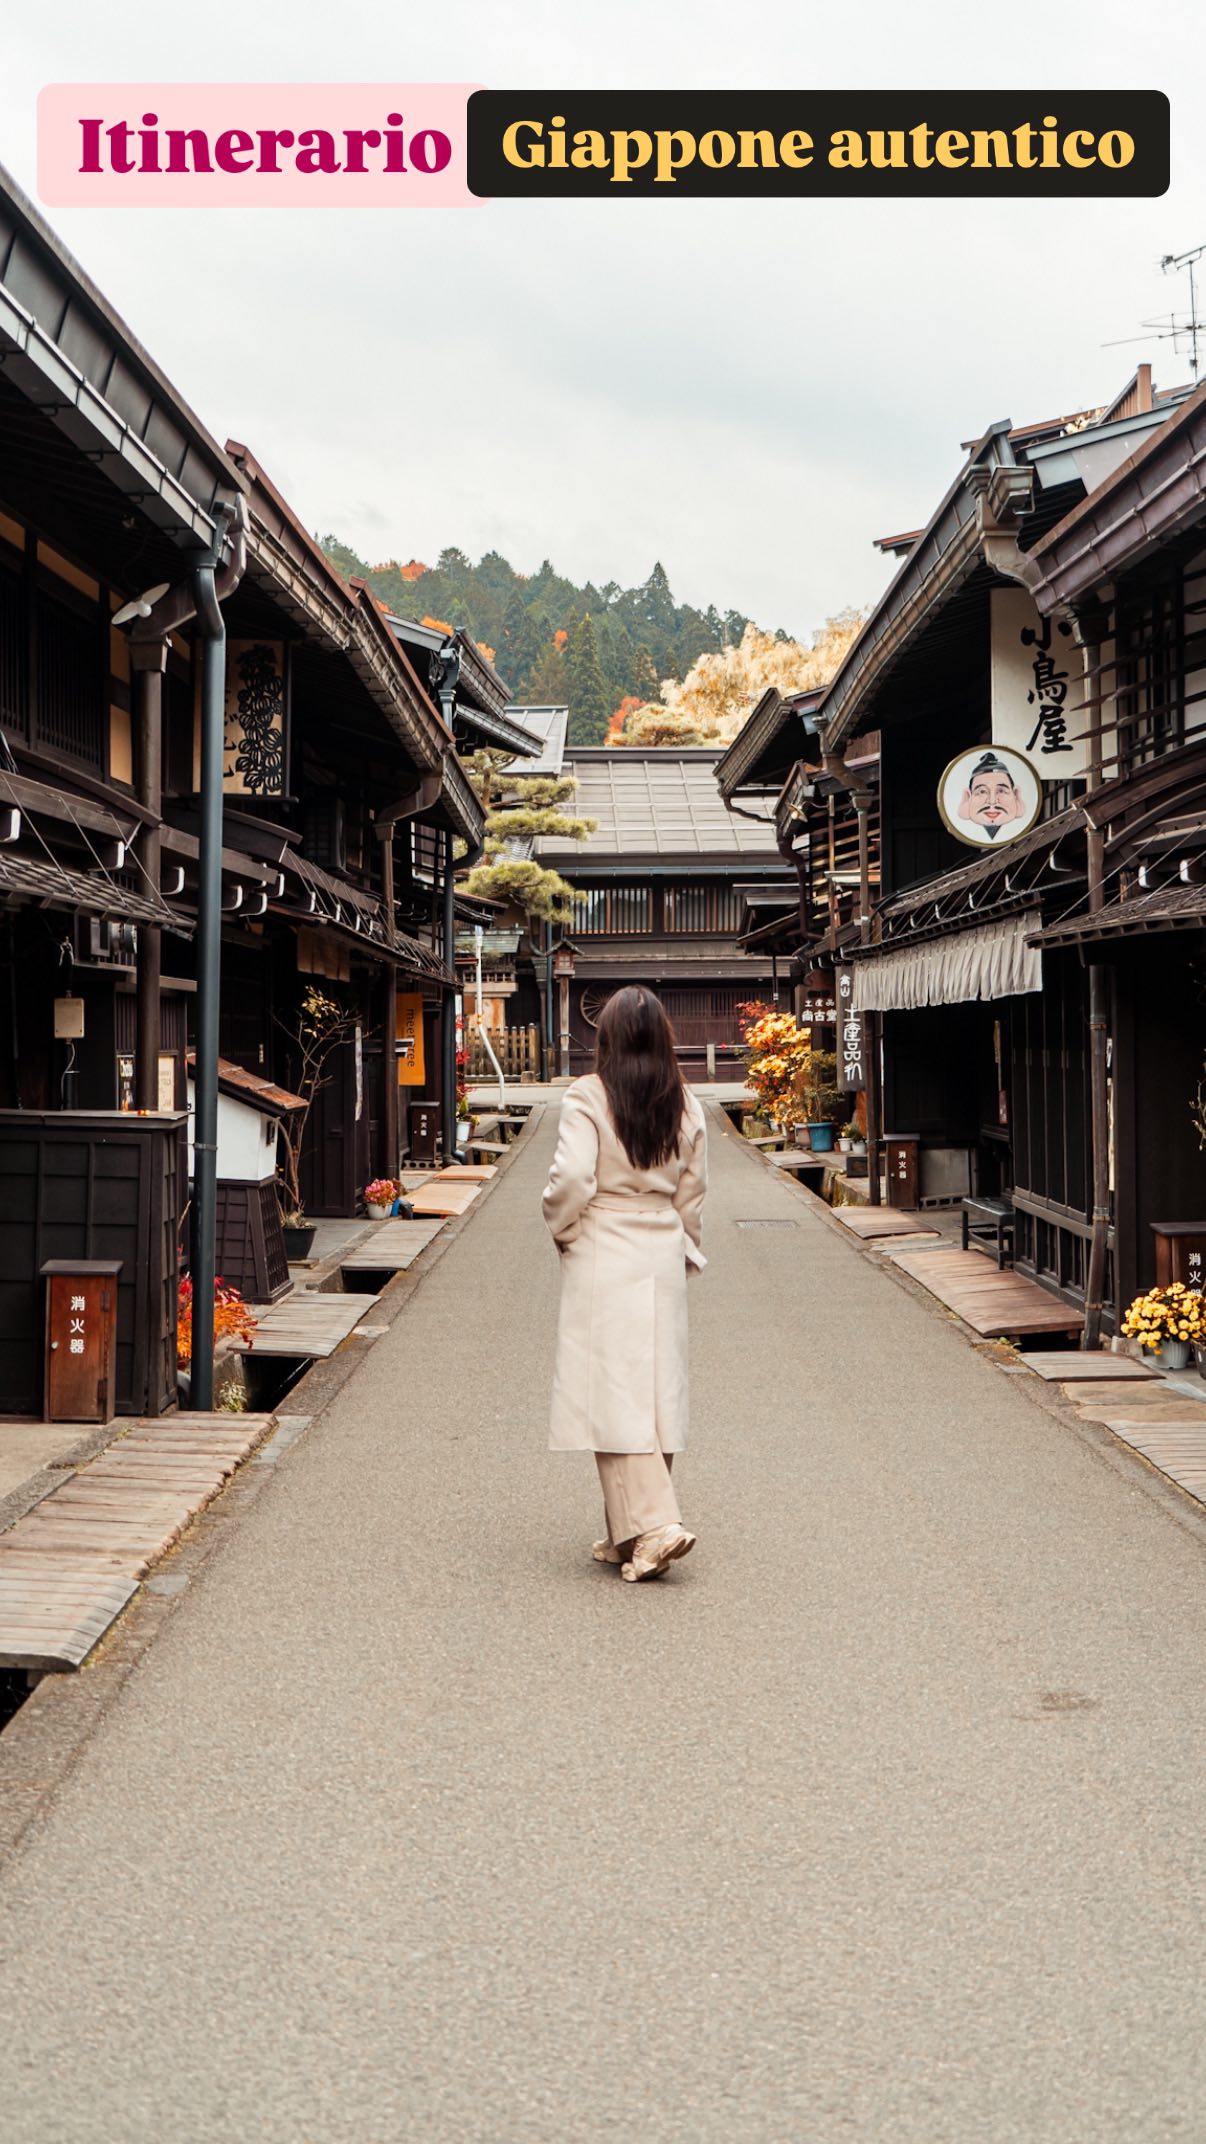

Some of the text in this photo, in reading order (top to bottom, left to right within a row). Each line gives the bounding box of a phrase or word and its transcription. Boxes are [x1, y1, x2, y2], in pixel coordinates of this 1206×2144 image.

[1021, 613, 1074, 755] 小鳥屋
[69, 1295, 85, 1354] 消火器
